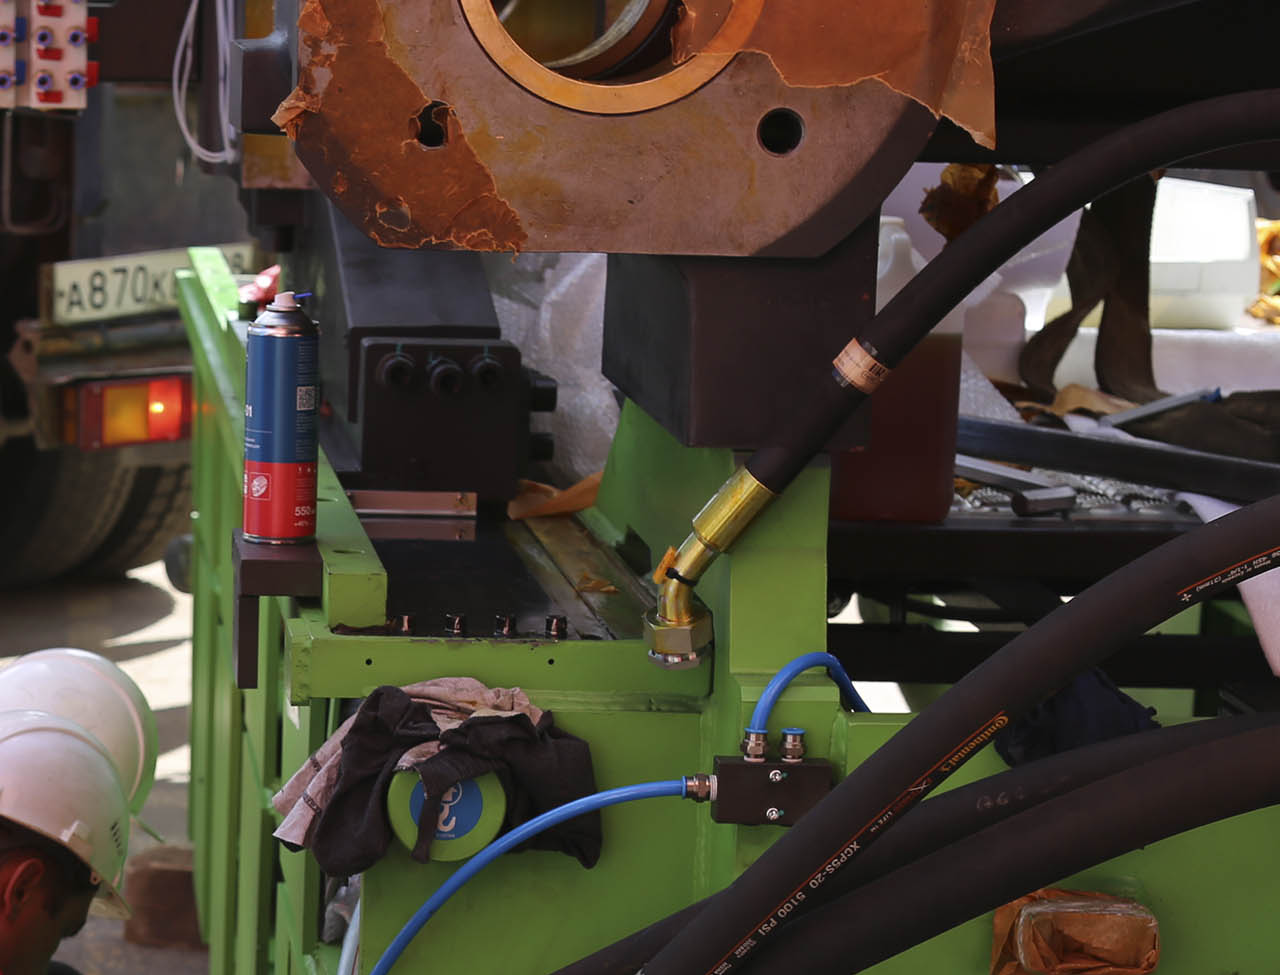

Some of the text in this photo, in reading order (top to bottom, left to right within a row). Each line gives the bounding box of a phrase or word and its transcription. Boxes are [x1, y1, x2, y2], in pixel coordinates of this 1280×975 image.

[949, 715, 1009, 767] Continental
[809, 840, 861, 889] XCP5S-20
[777, 891, 807, 918] 5100
[758, 917, 778, 936] PSI
